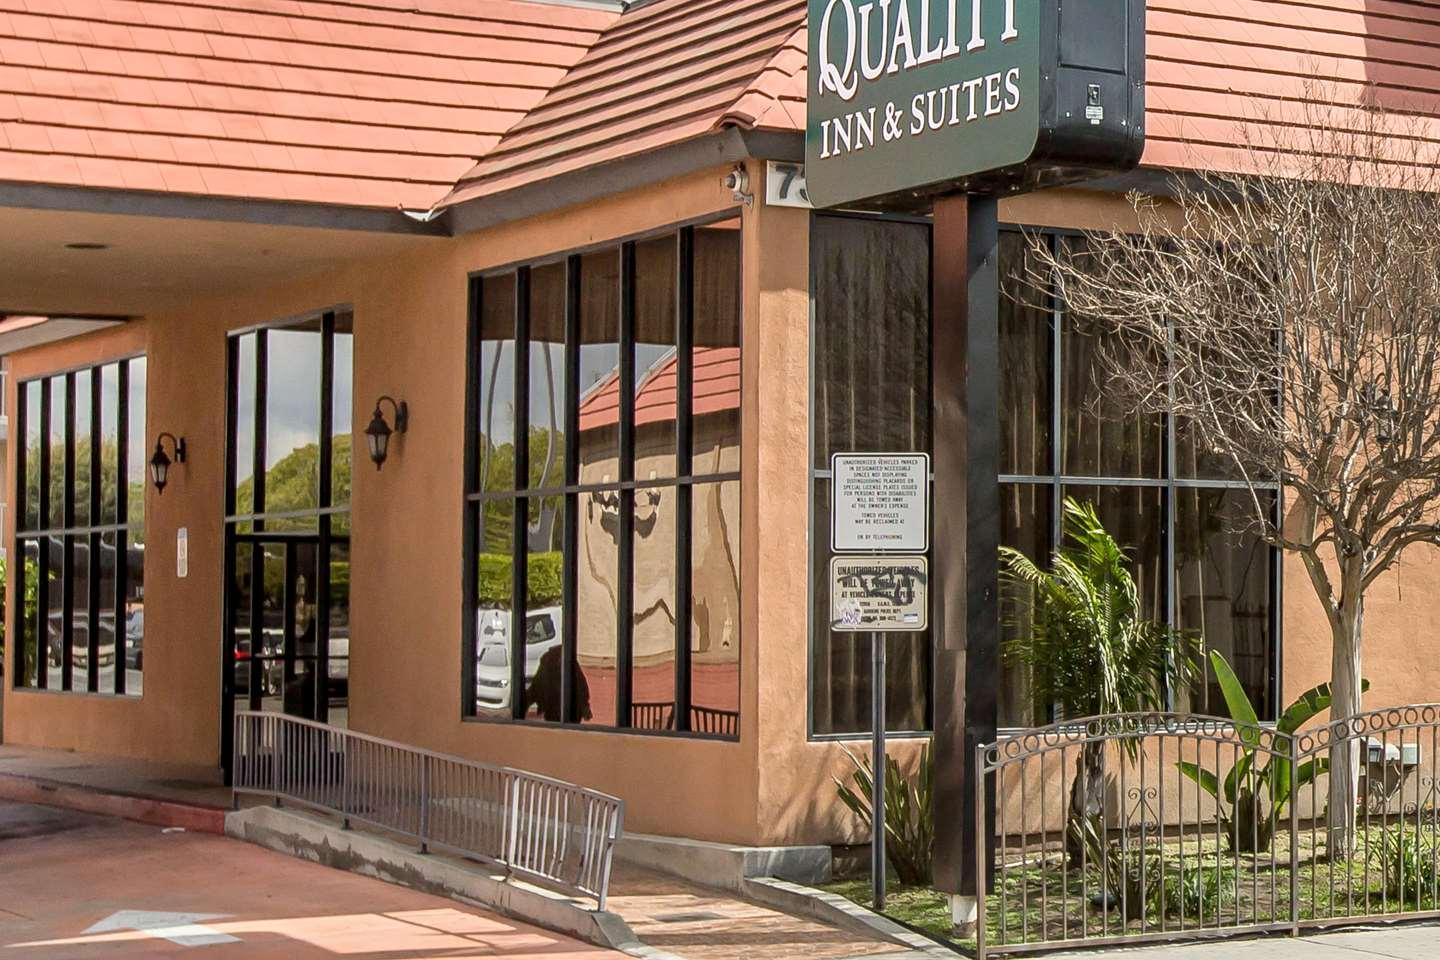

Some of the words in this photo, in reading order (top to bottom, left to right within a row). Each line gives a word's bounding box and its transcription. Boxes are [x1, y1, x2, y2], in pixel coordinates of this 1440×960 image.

[820, 107, 876, 159] INN
[882, 102, 903, 142] &
[910, 68, 1020, 135] SUITES
